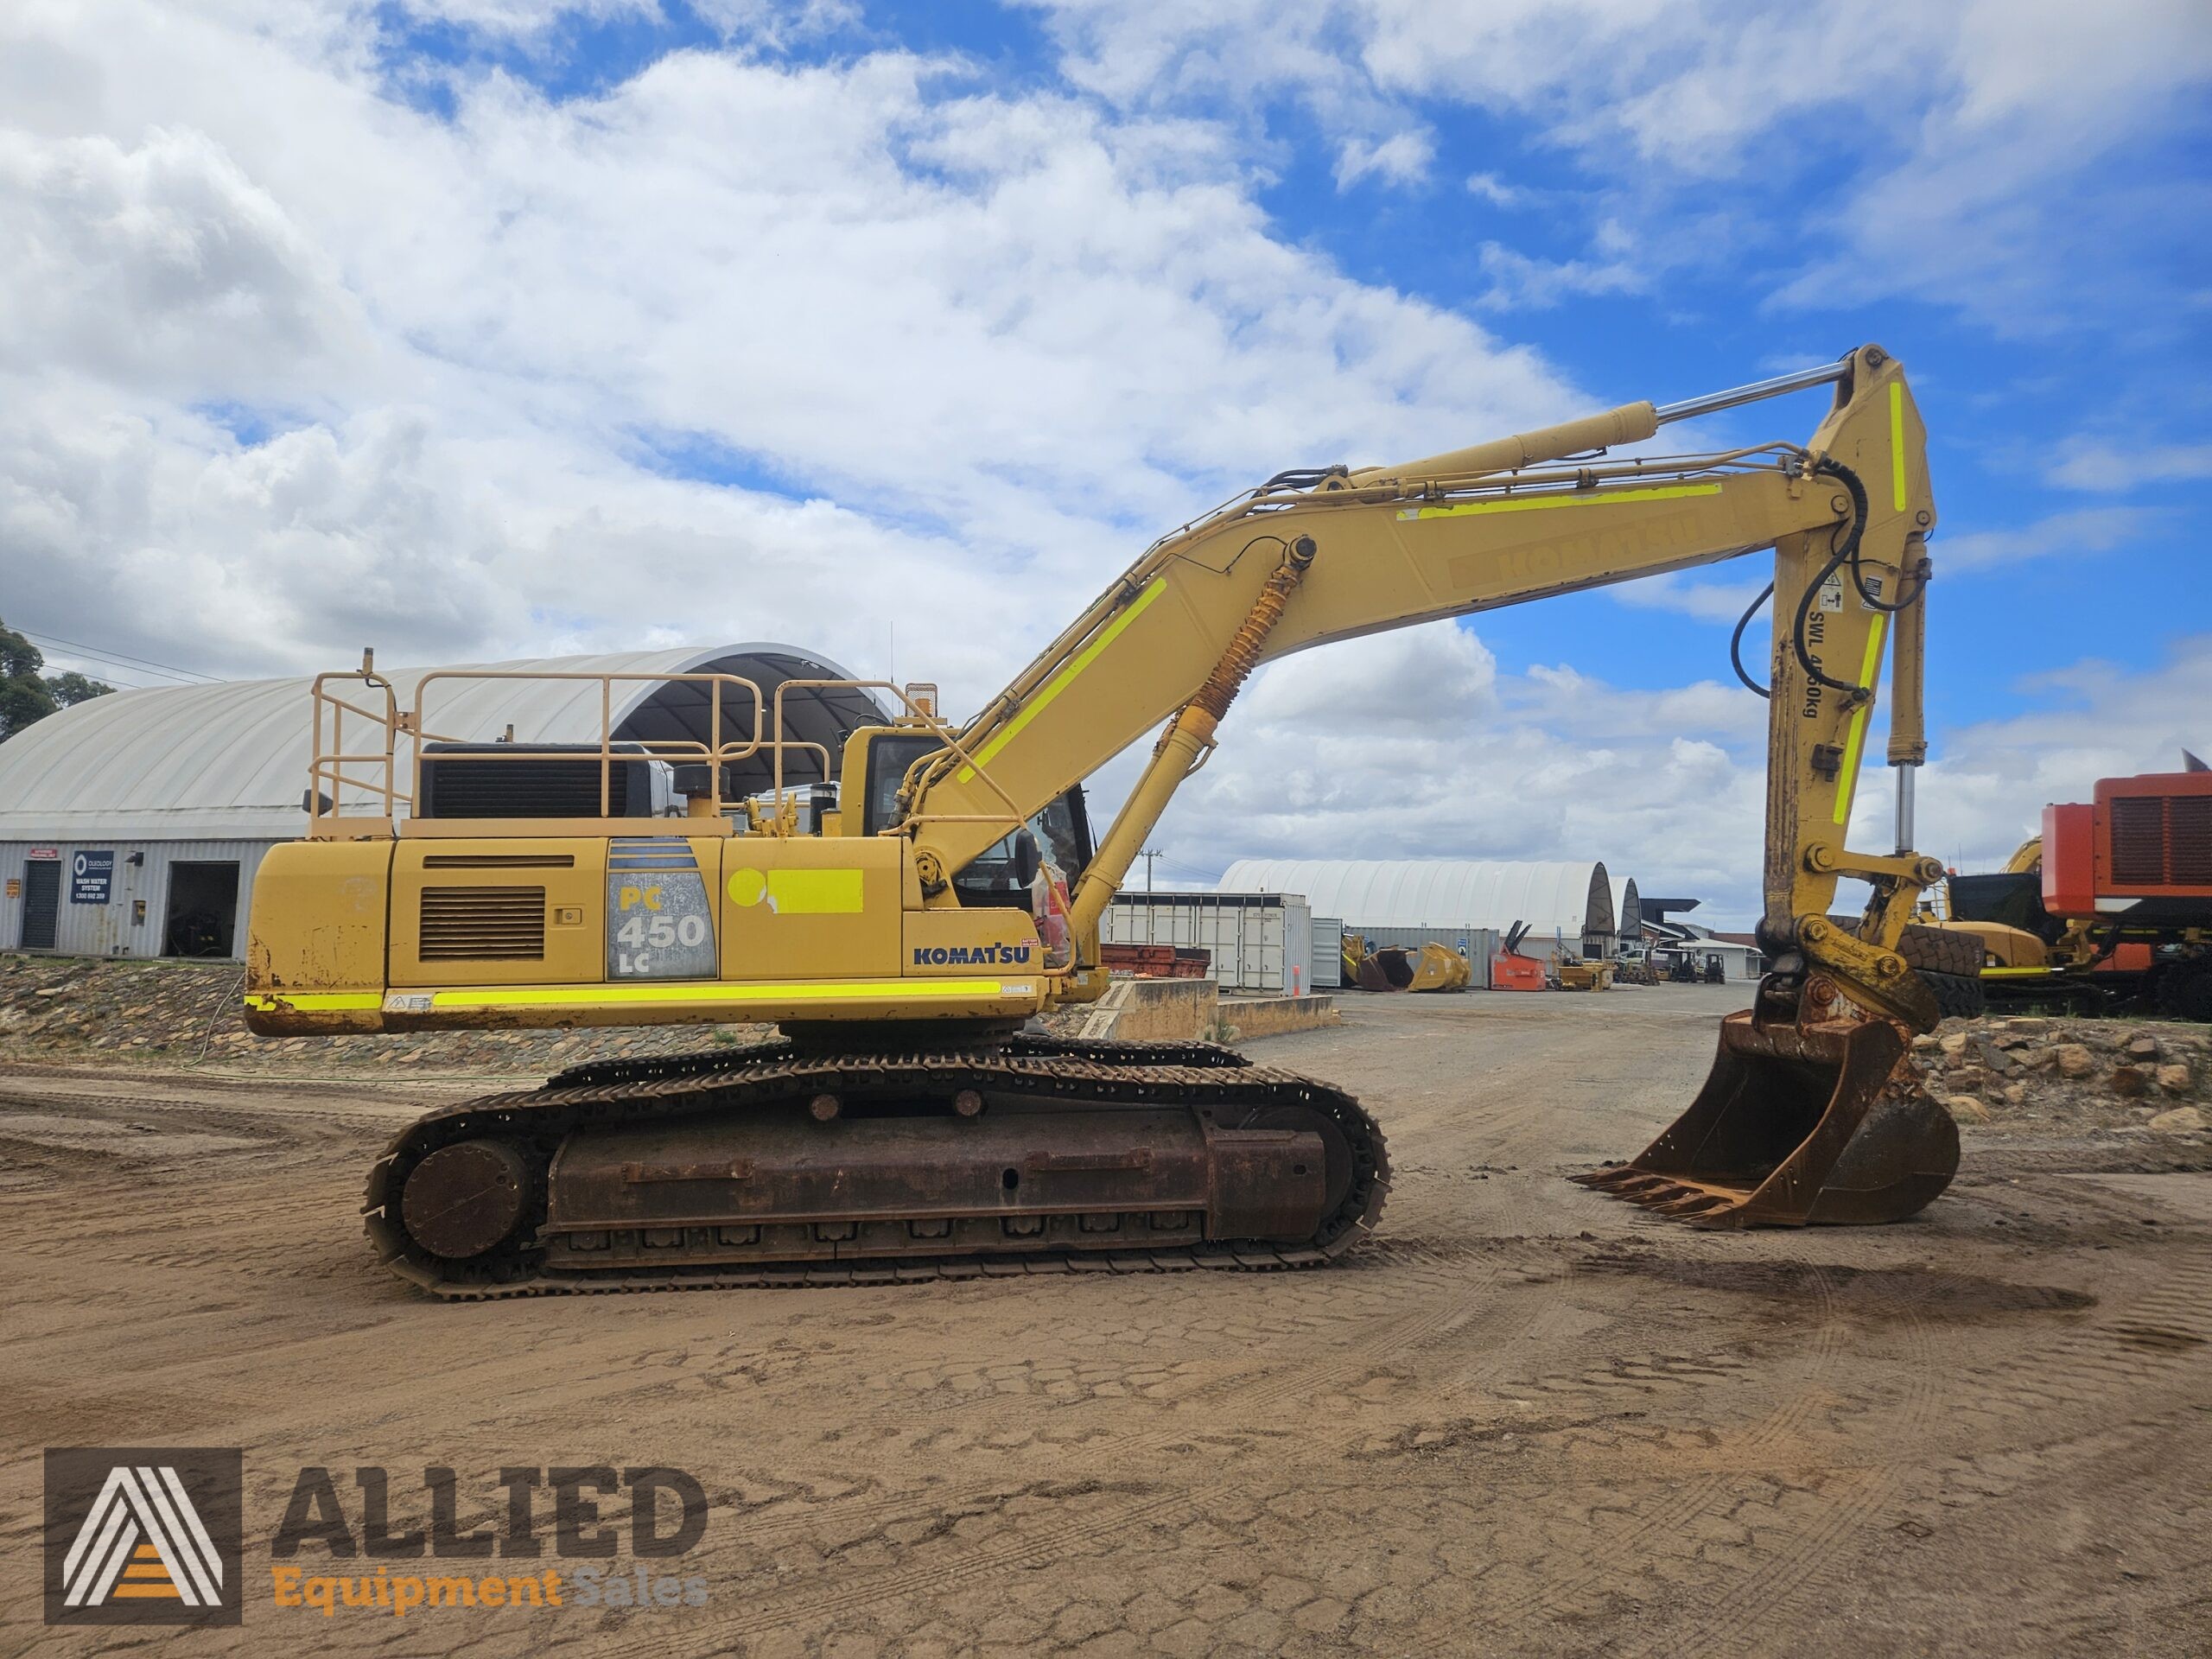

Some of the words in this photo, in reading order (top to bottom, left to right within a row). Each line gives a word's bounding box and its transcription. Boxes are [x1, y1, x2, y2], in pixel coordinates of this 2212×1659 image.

[1808, 612, 1824, 647] SWL
[619, 886, 662, 912] PC
[617, 914, 706, 948] 450
[619, 952, 650, 973] LC
[913, 942, 1030, 965] KOMATSU
